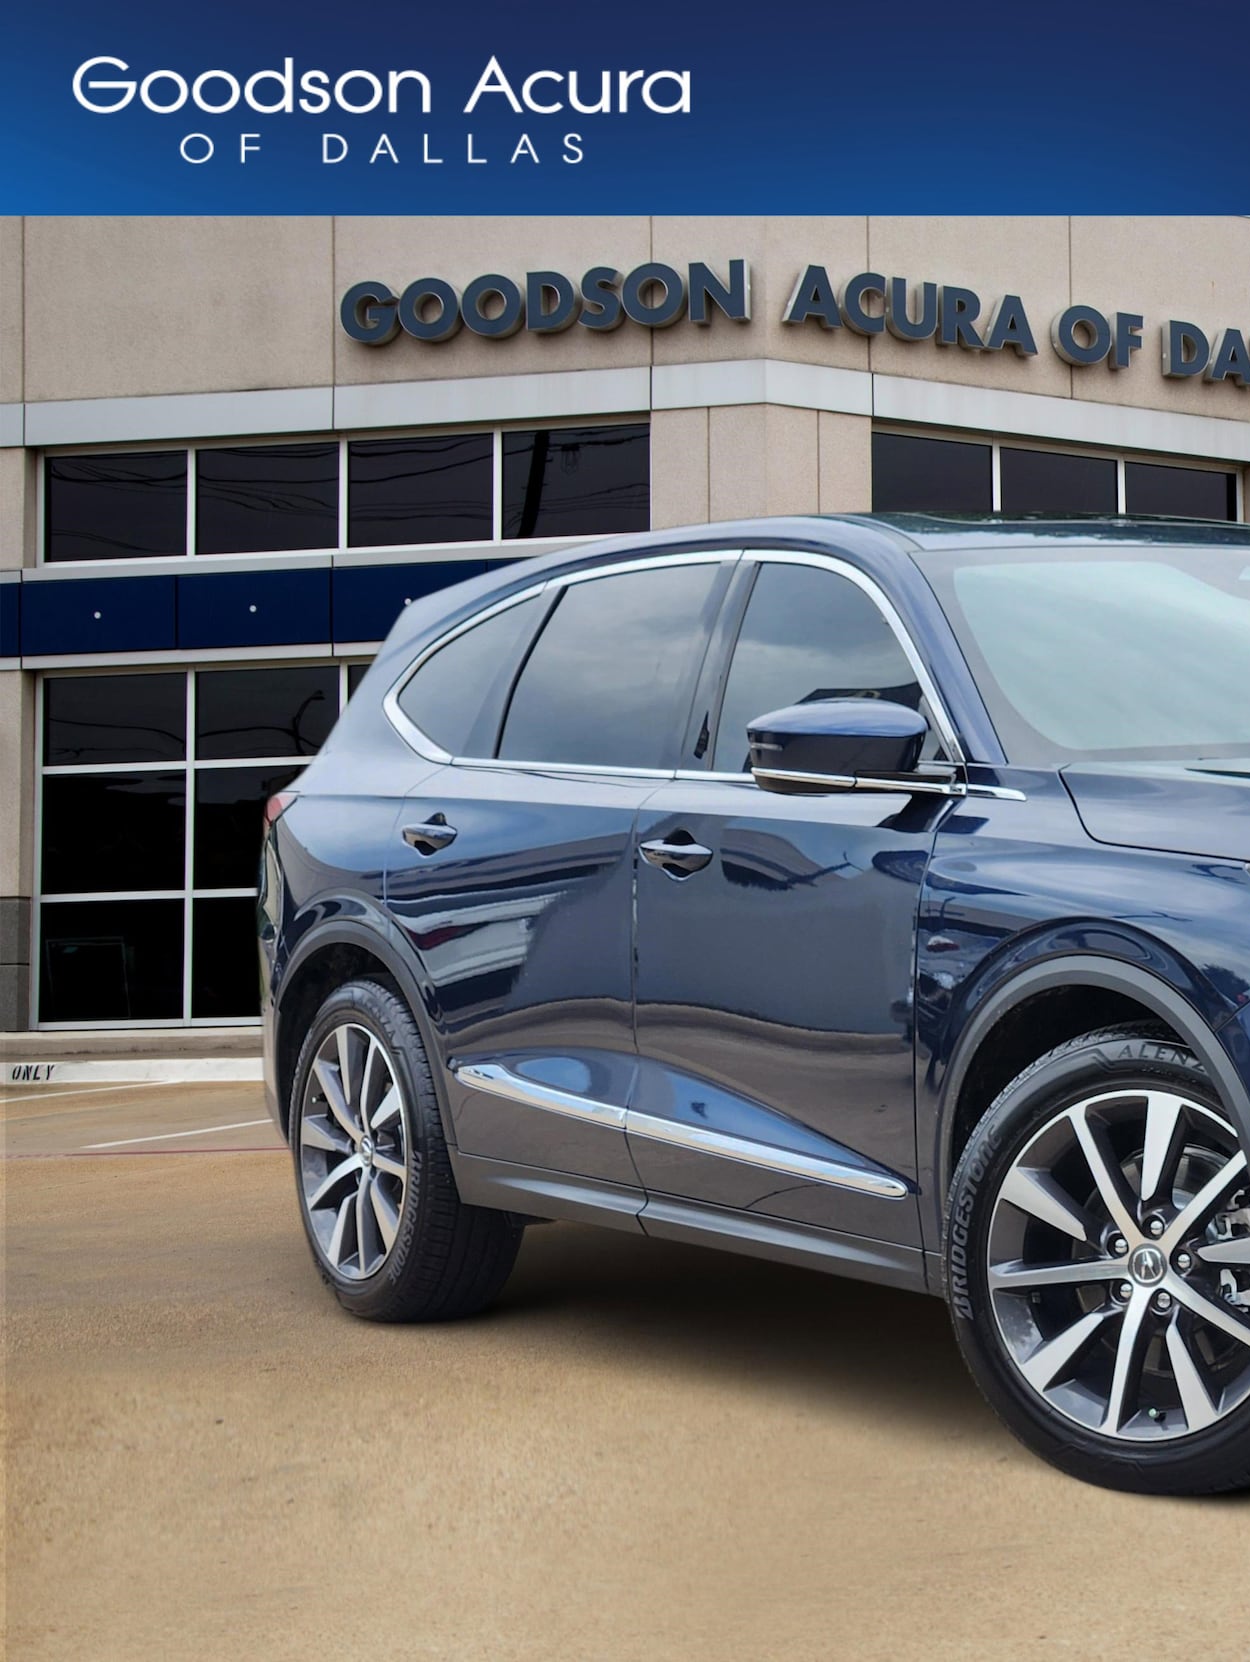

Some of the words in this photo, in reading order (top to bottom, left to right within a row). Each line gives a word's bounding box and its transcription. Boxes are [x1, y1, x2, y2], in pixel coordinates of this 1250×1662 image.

[340, 258, 752, 346] GOODSON
[782, 264, 1038, 357] ACURA
[1051, 304, 1144, 370] OF
[12, 1064, 55, 1081] ONLY
[1117, 1044, 1206, 1073] ALENZ
